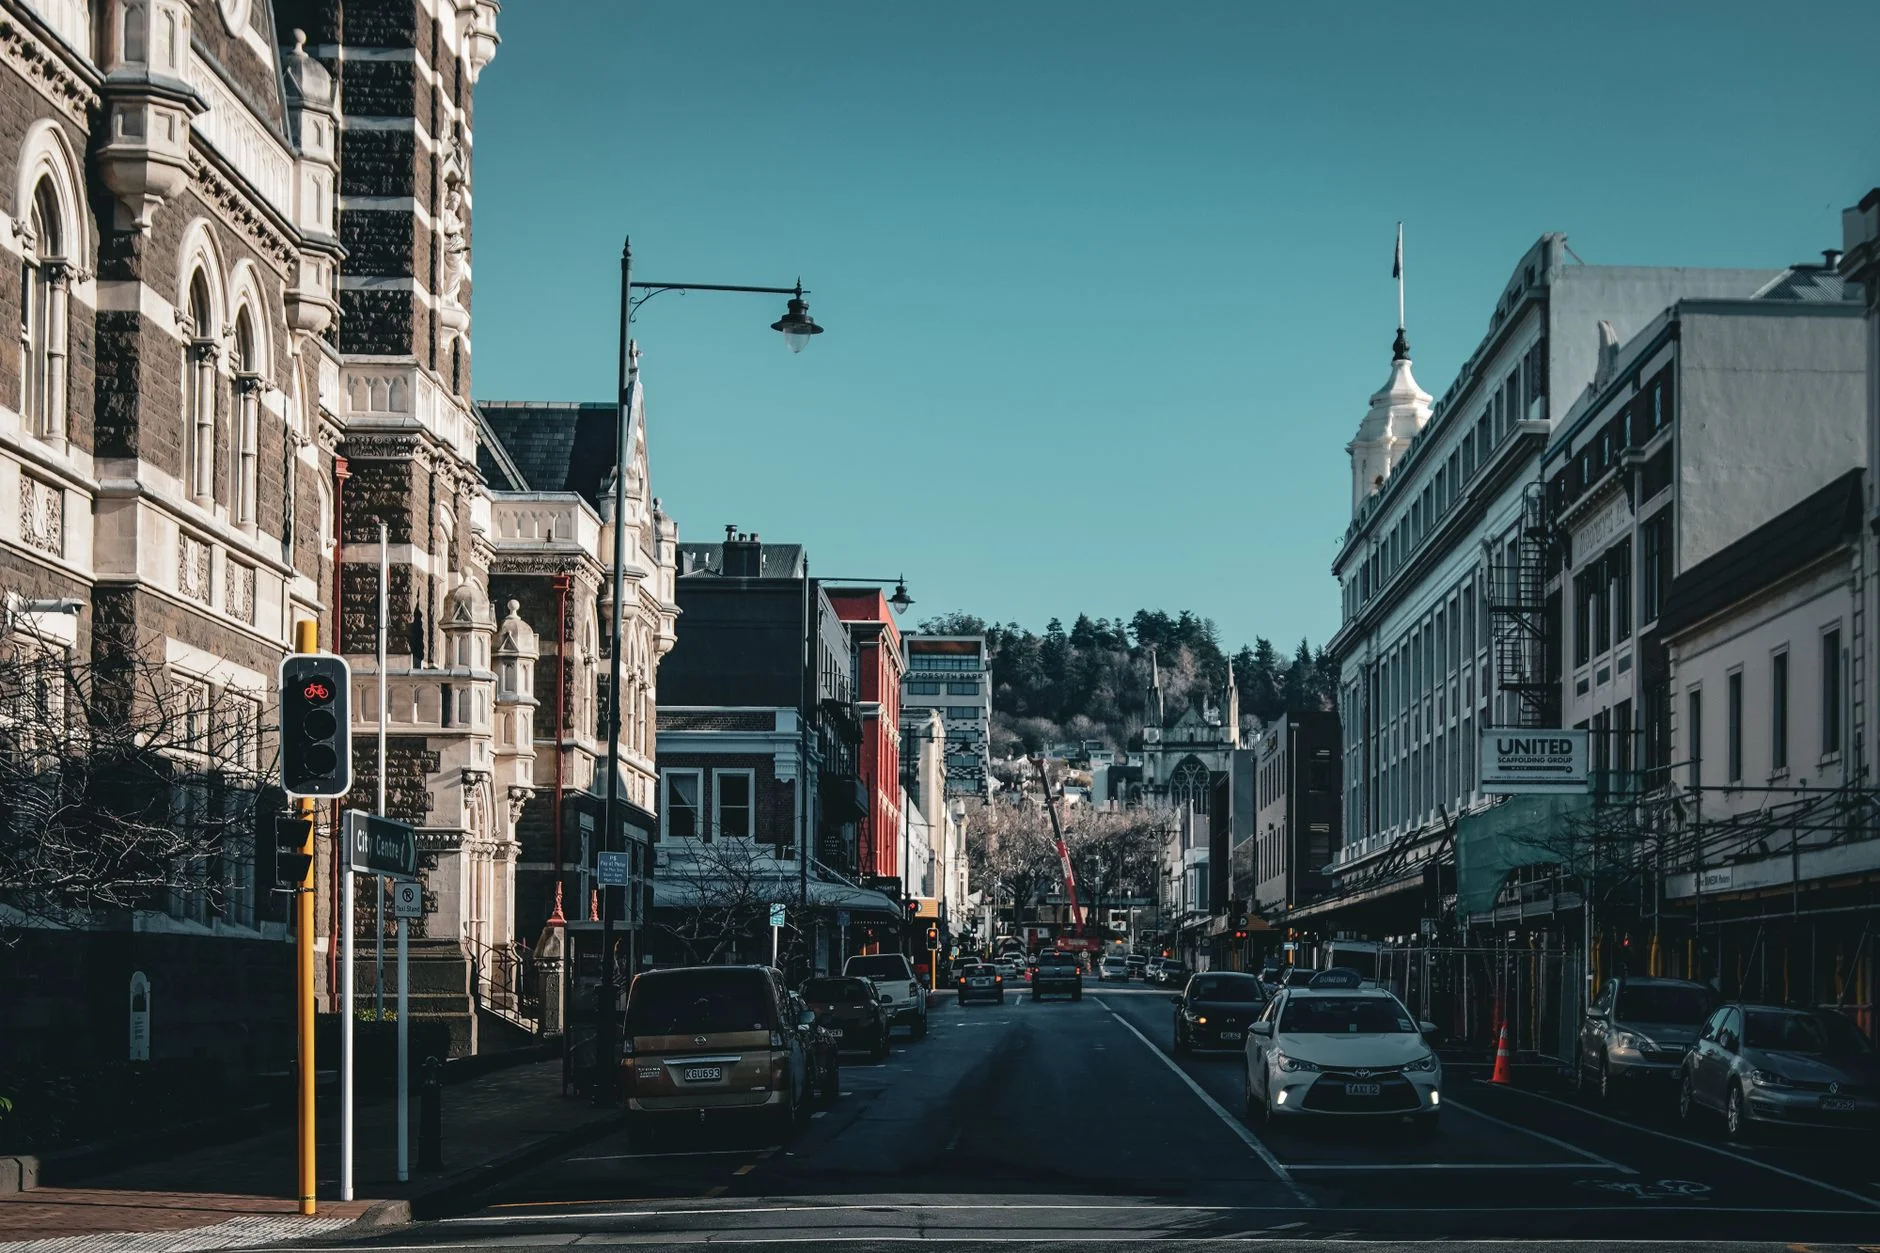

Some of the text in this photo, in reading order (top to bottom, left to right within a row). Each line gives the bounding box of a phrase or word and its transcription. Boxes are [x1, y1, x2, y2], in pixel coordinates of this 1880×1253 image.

[915, 672, 984, 681] FORSYTH BARR
[1497, 738, 1573, 755] UNITED
[357, 829, 373, 859] City
[376, 834, 400, 860] Centre
[685, 1067, 721, 1080] KGU693
